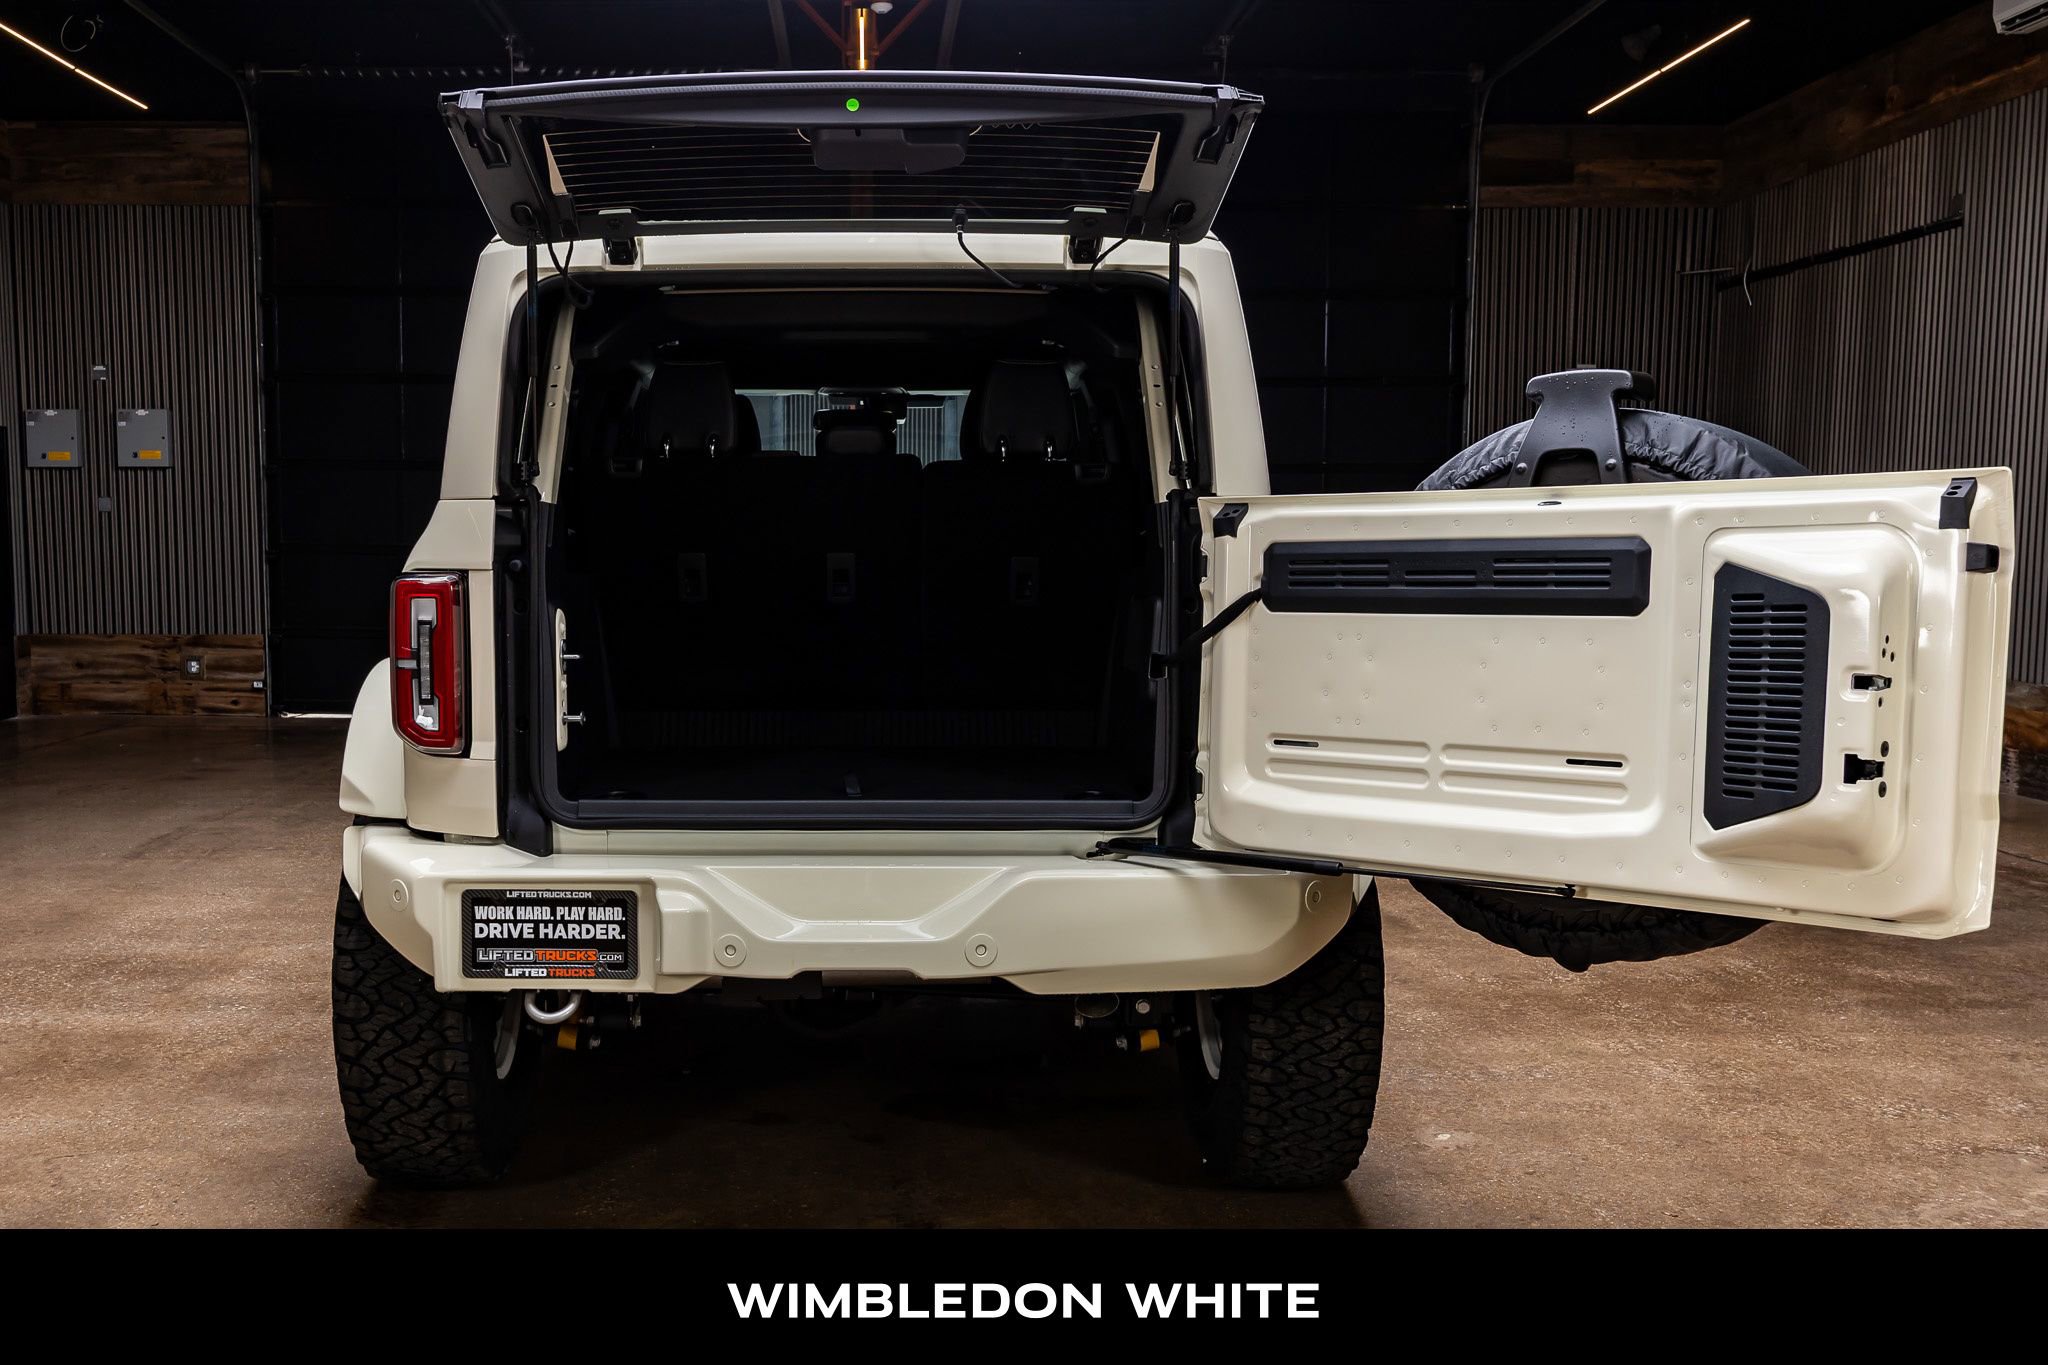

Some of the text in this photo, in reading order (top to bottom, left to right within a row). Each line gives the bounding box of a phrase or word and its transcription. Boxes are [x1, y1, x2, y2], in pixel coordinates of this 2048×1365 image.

[474, 905, 626, 921] WORK HARD. PLAY HARD.
[474, 922, 626, 940] DRIVE HARDER.
